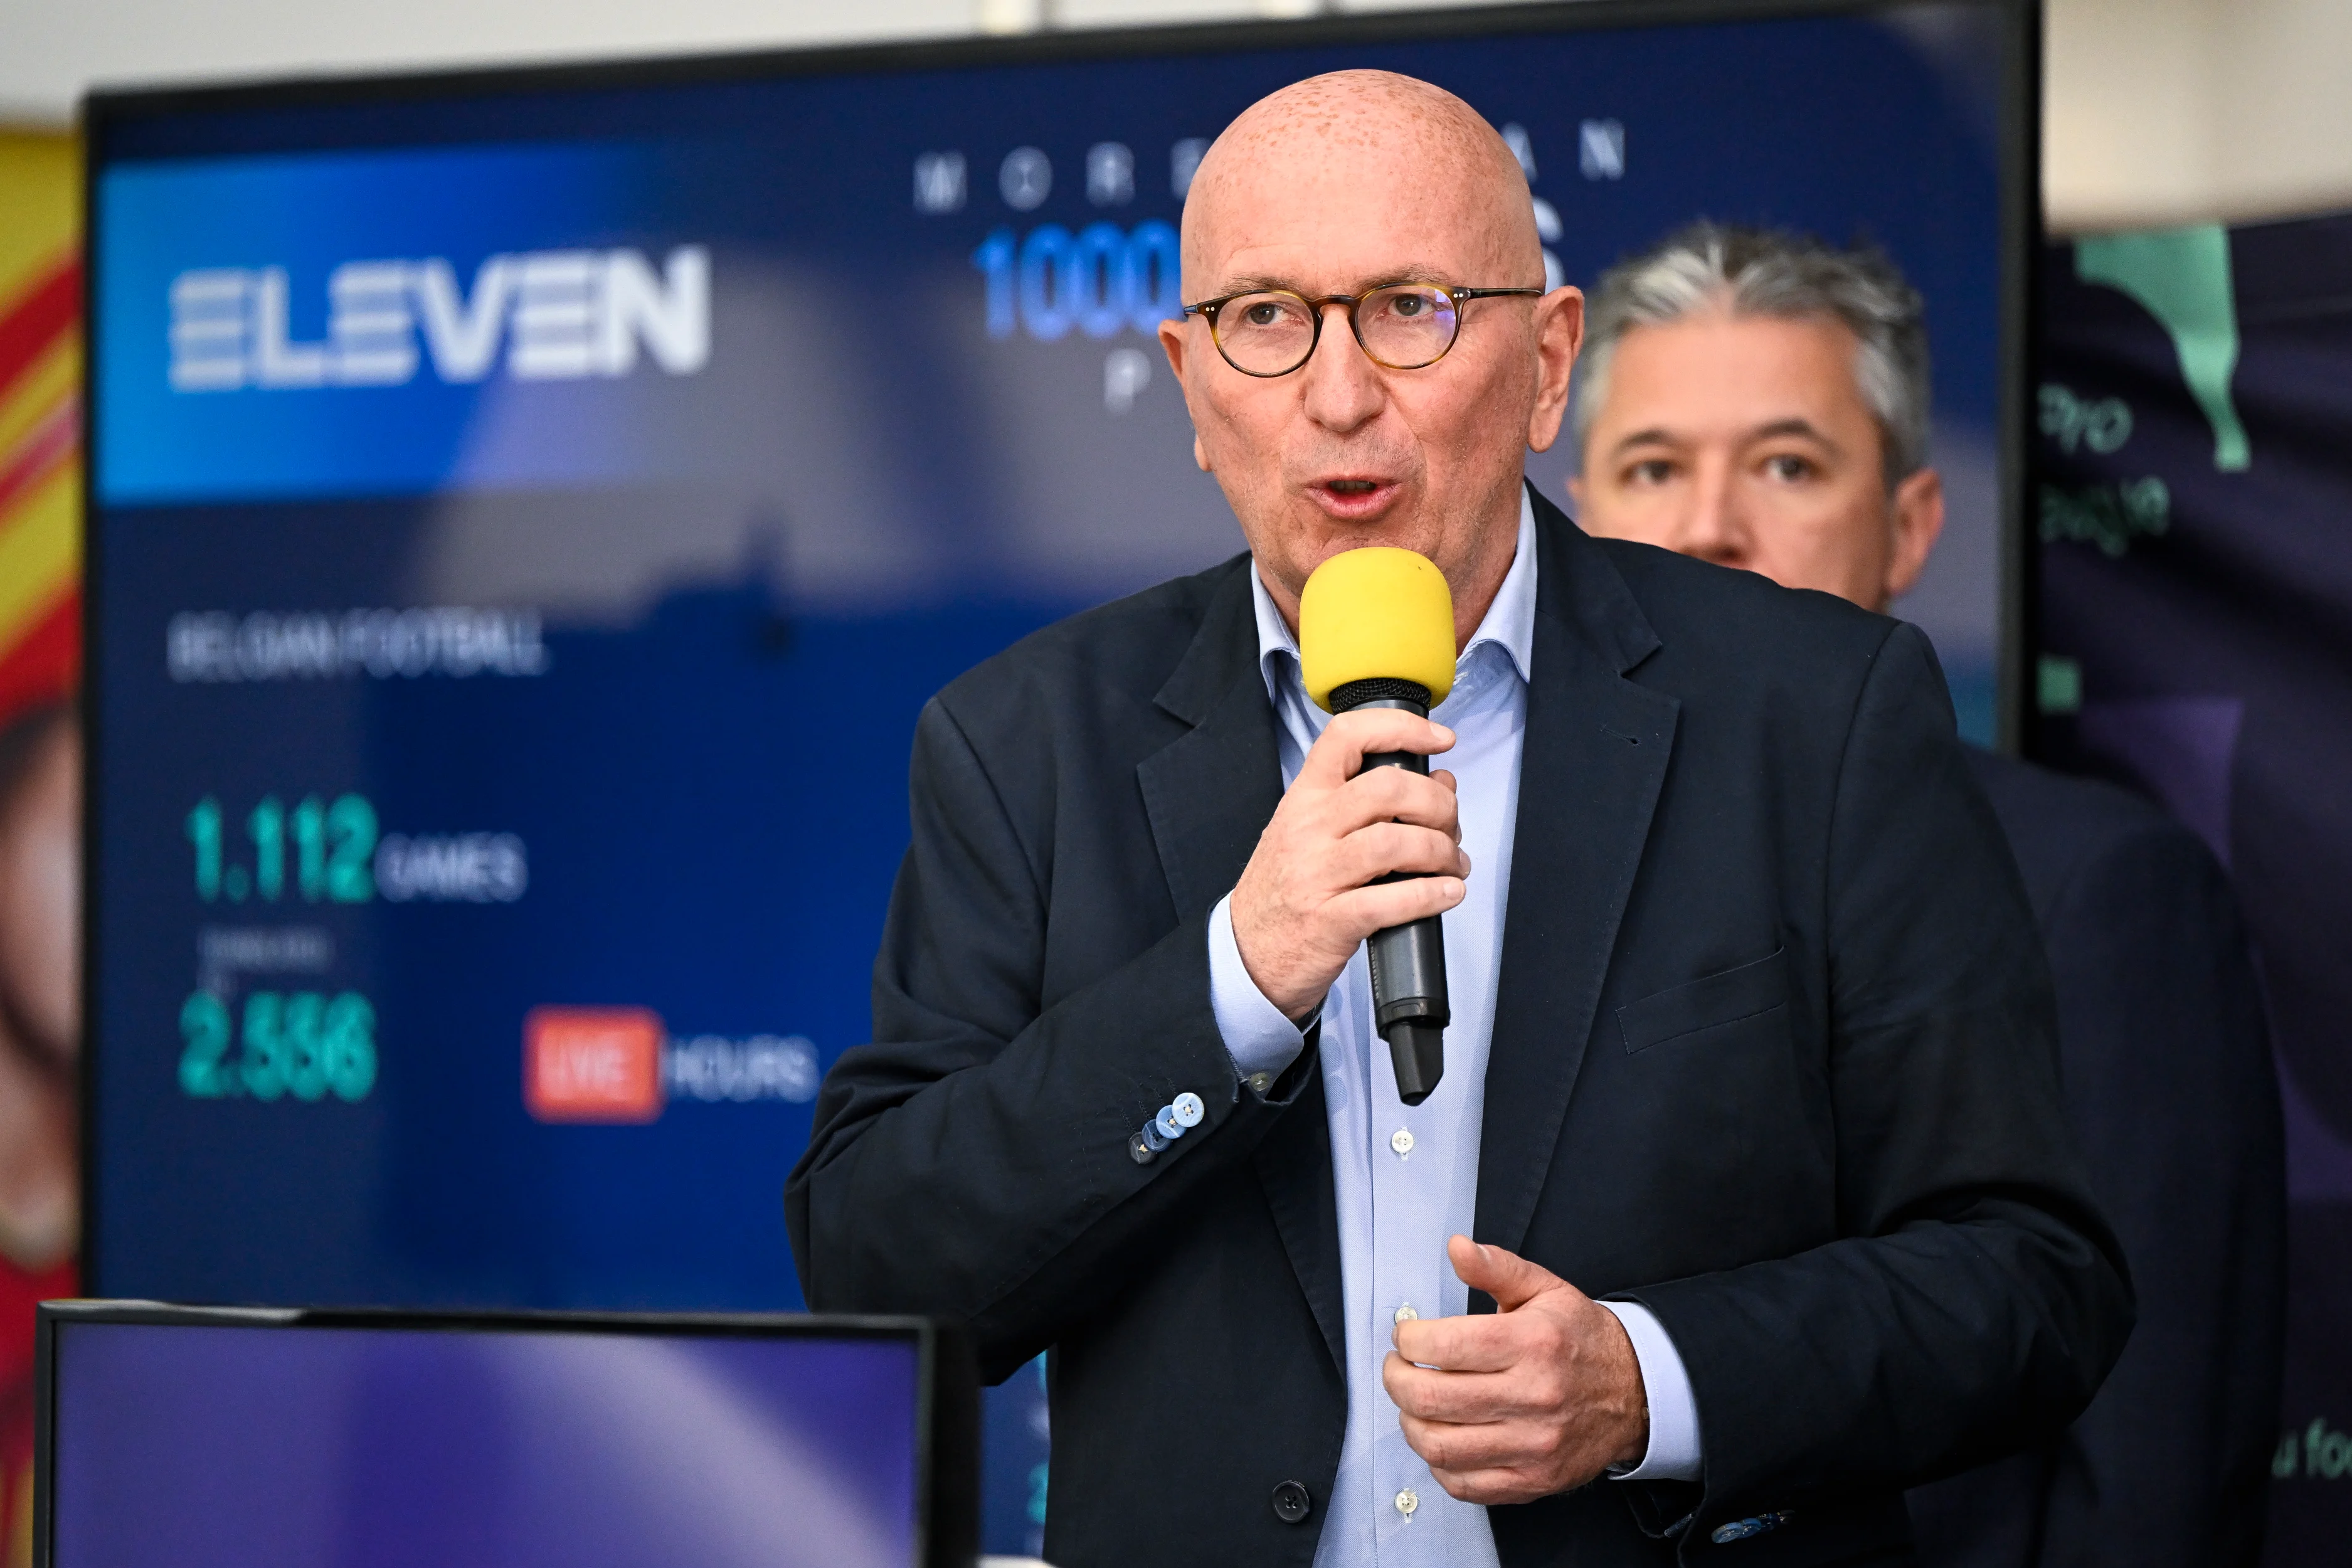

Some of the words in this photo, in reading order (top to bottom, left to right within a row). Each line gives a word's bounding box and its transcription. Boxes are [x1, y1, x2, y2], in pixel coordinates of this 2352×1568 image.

[172, 247, 708, 389] ELEVEN
[168, 612, 339, 682] BELGIAN
[342, 607, 549, 677] FOOTBALL
[185, 793, 375, 903] 1.112
[377, 832, 527, 902] GAMES
[539, 1034, 636, 1099] LIVE
[661, 1035, 818, 1102] HOURS
